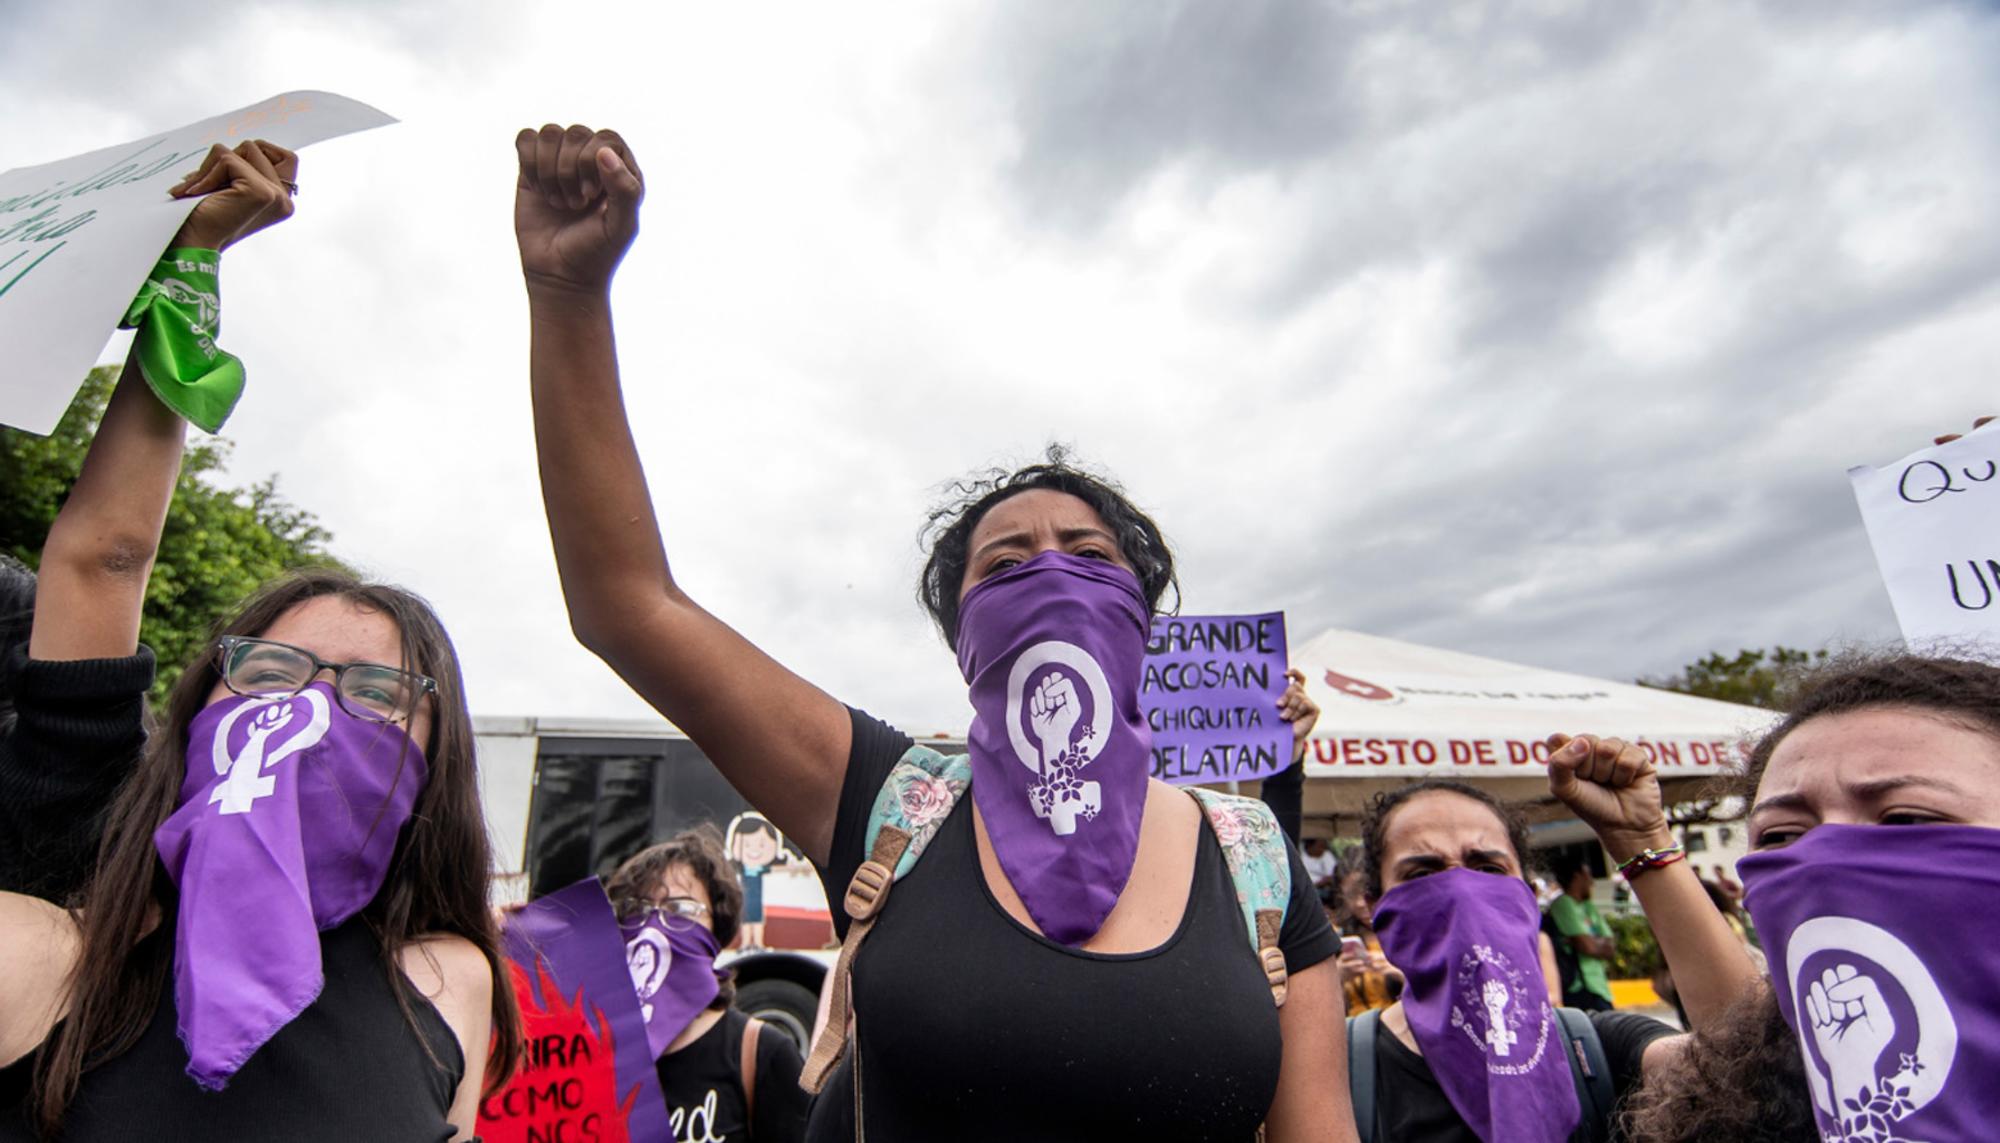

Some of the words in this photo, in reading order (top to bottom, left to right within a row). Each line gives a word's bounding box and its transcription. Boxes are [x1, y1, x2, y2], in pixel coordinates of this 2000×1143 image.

[176, 260, 196, 272] Es
[1145, 617, 1277, 655] GRANDE
[1142, 660, 1269, 694] ACOSAN
[1147, 705, 1263, 732] CHIQUITA
[1149, 741, 1278, 778] DELATAN
[1448, 739, 1497, 765] DE
[1688, 741, 1728, 766] DE
[521, 1033, 593, 1074] IRA
[479, 1077, 585, 1121] COMO
